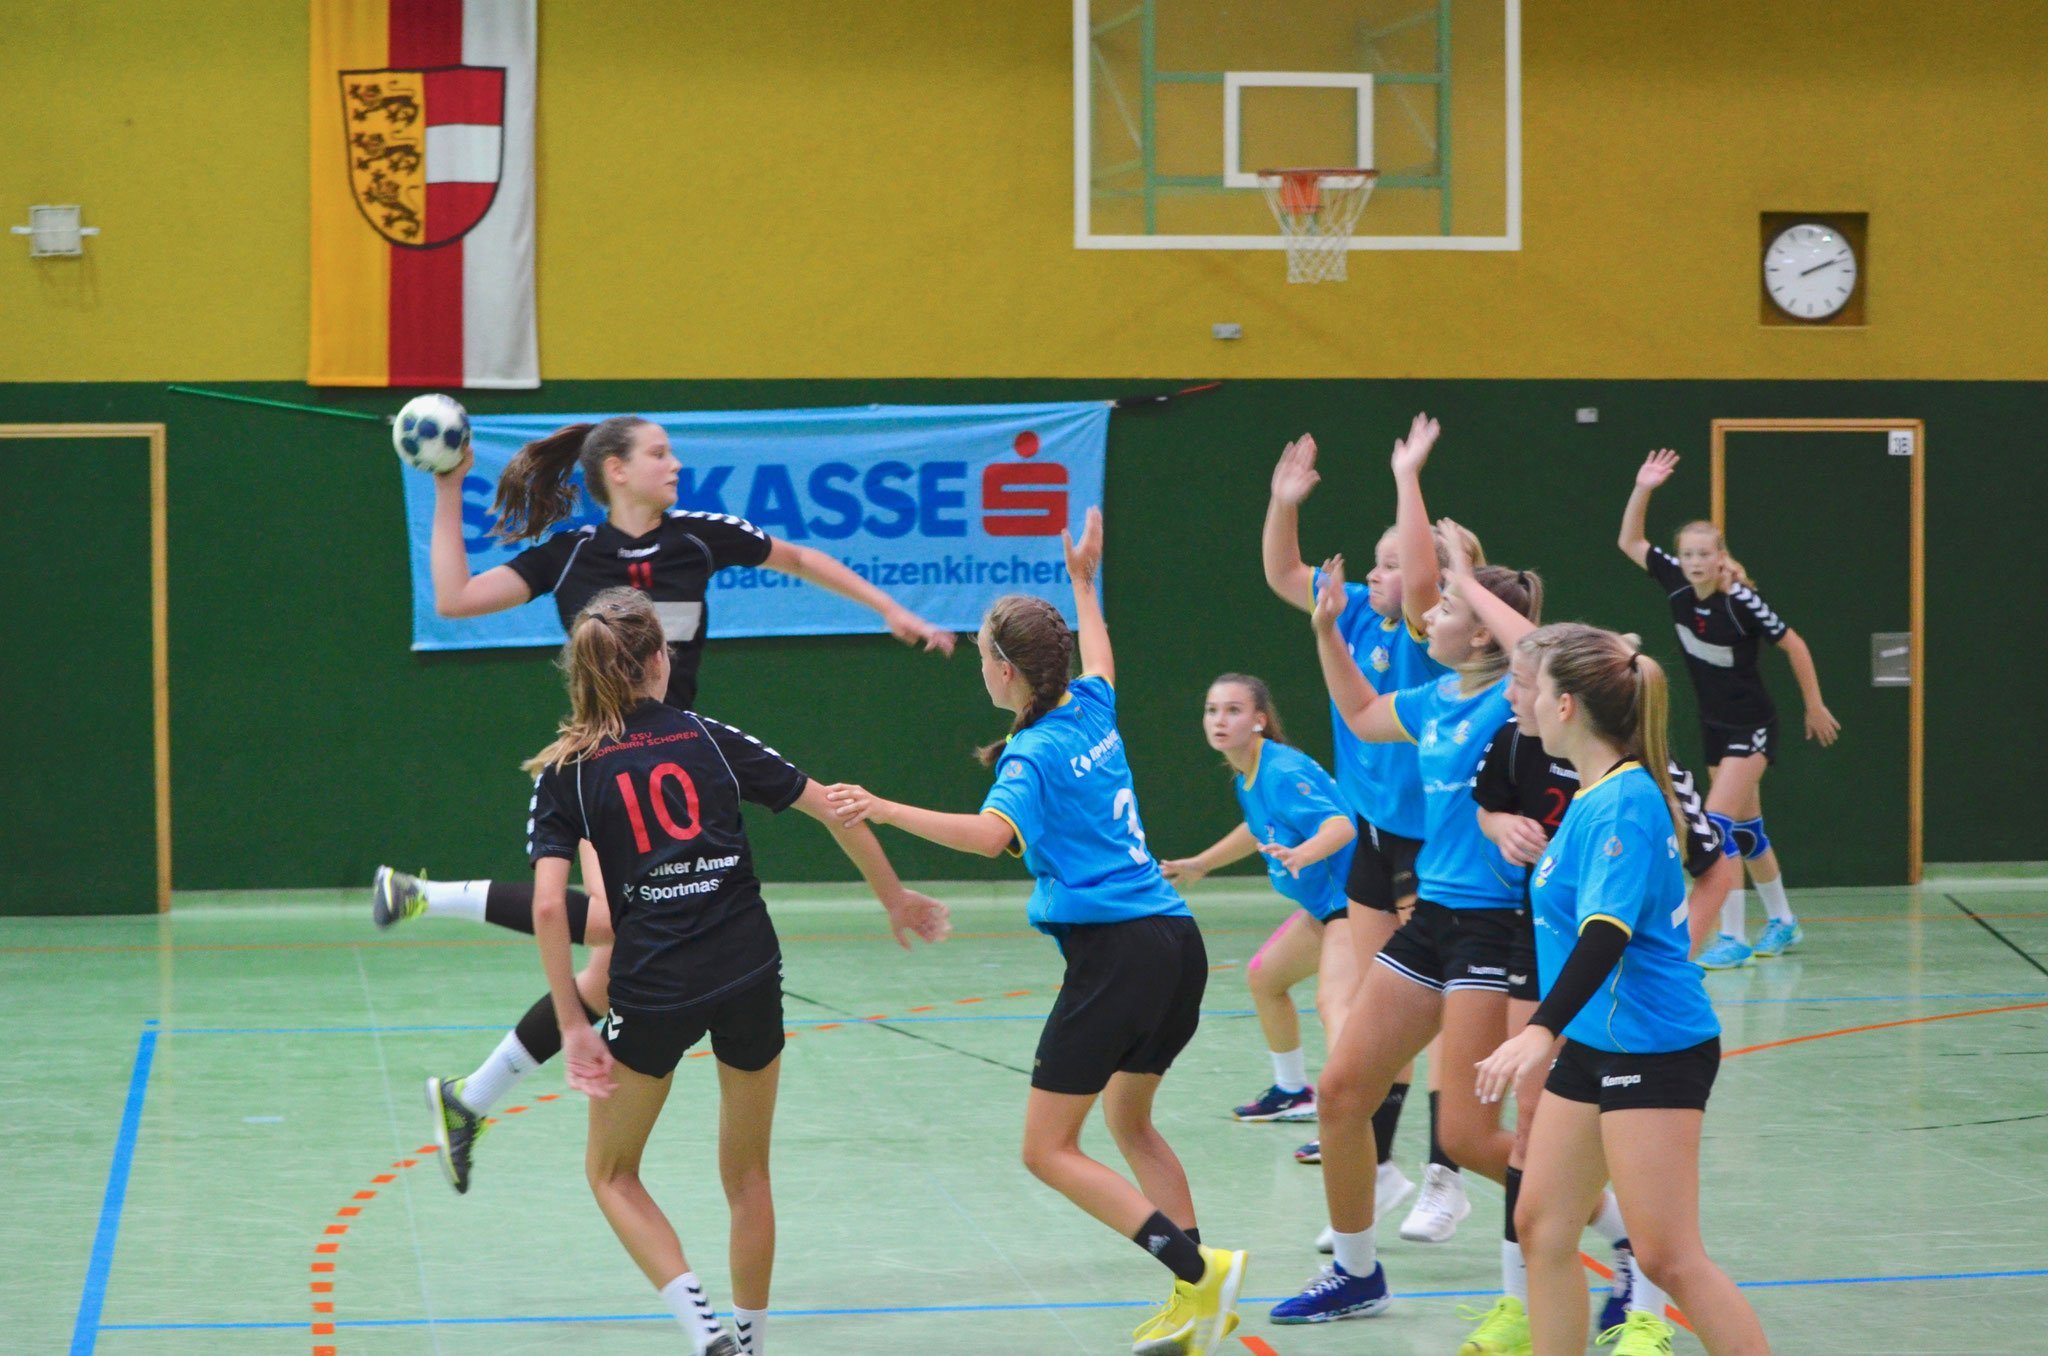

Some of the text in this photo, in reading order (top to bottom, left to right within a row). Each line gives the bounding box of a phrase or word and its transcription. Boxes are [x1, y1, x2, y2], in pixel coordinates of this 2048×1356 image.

[843, 555, 1073, 586] aizenkirchen
[629, 731, 653, 741] SSV
[646, 730, 699, 746] SCHOREN
[615, 762, 702, 854] 10
[1113, 788, 1150, 866] 3
[639, 878, 724, 904] Sportmas
[1601, 1073, 1642, 1088] Kempa
